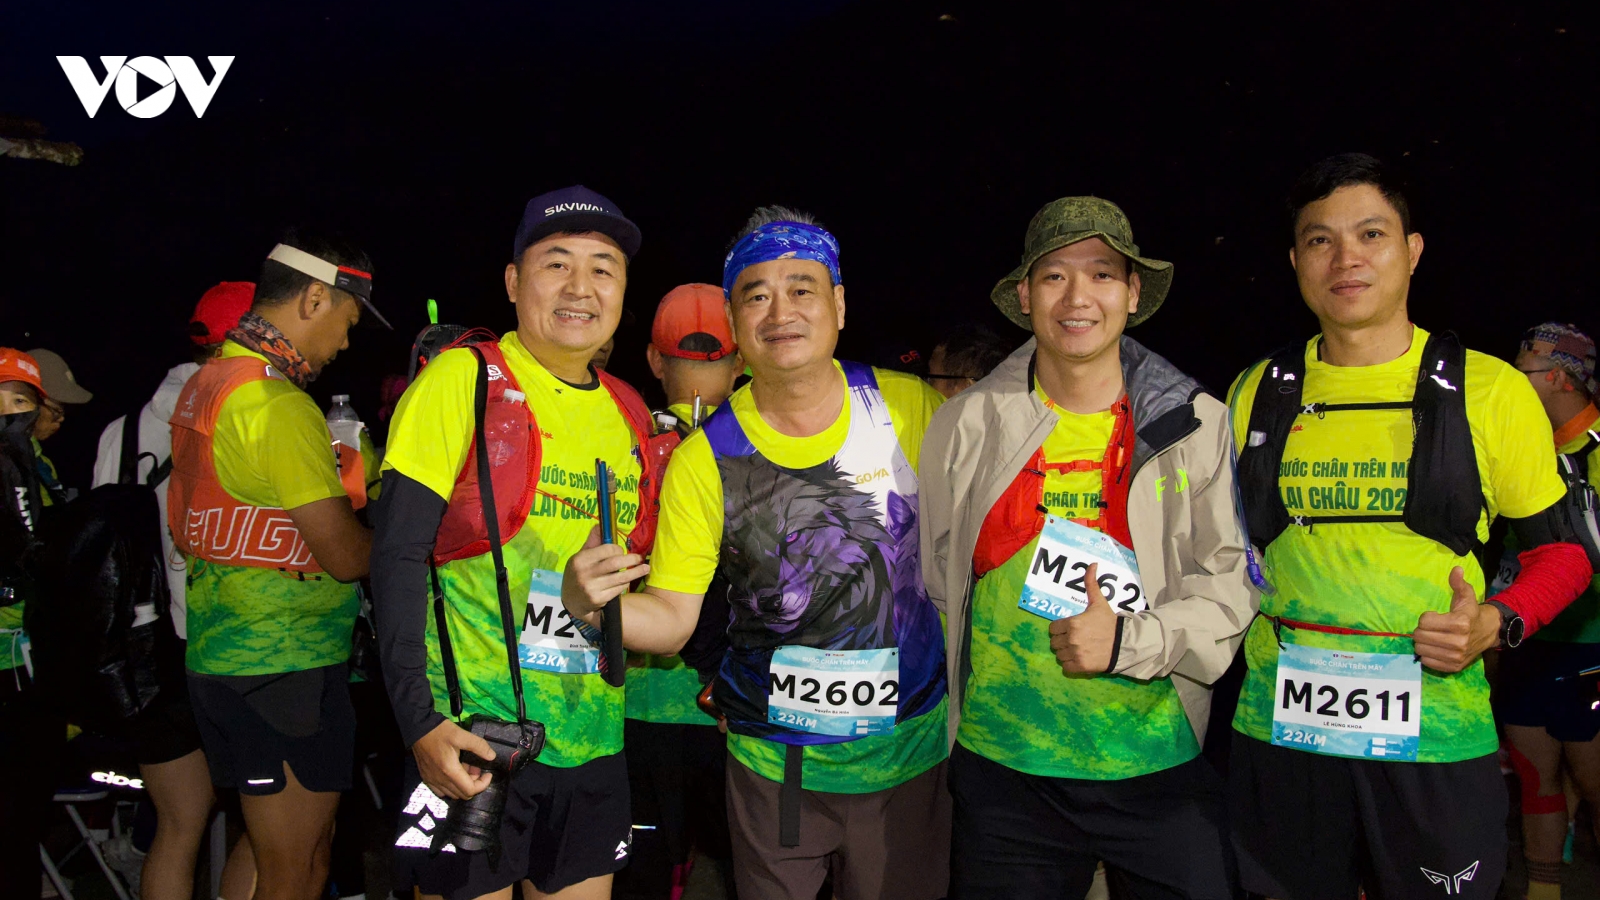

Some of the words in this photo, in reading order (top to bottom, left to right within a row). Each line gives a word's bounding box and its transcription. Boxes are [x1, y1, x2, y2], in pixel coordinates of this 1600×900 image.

[544, 202, 609, 217] SKYWA
[539, 463, 567, 487] ƯỚC
[1278, 457, 1308, 478] BƯỚC
[1312, 457, 1349, 478] CHÂN
[1353, 457, 1386, 478] TRÊN
[1043, 491, 1079, 508] CHÂN
[1082, 490, 1102, 509] TR
[1279, 486, 1305, 510] LAI
[1308, 480, 1360, 511] CHÂU
[1366, 487, 1408, 511] 202
[1031, 547, 1142, 613] M262
[1028, 595, 1073, 618] 22KM
[522, 602, 575, 639] M2
[526, 652, 569, 668] 22KM
[769, 672, 899, 706] M2602
[1282, 679, 1411, 722] M2611
[777, 712, 818, 729] 22KM
[1282, 729, 1327, 747] 22KM
